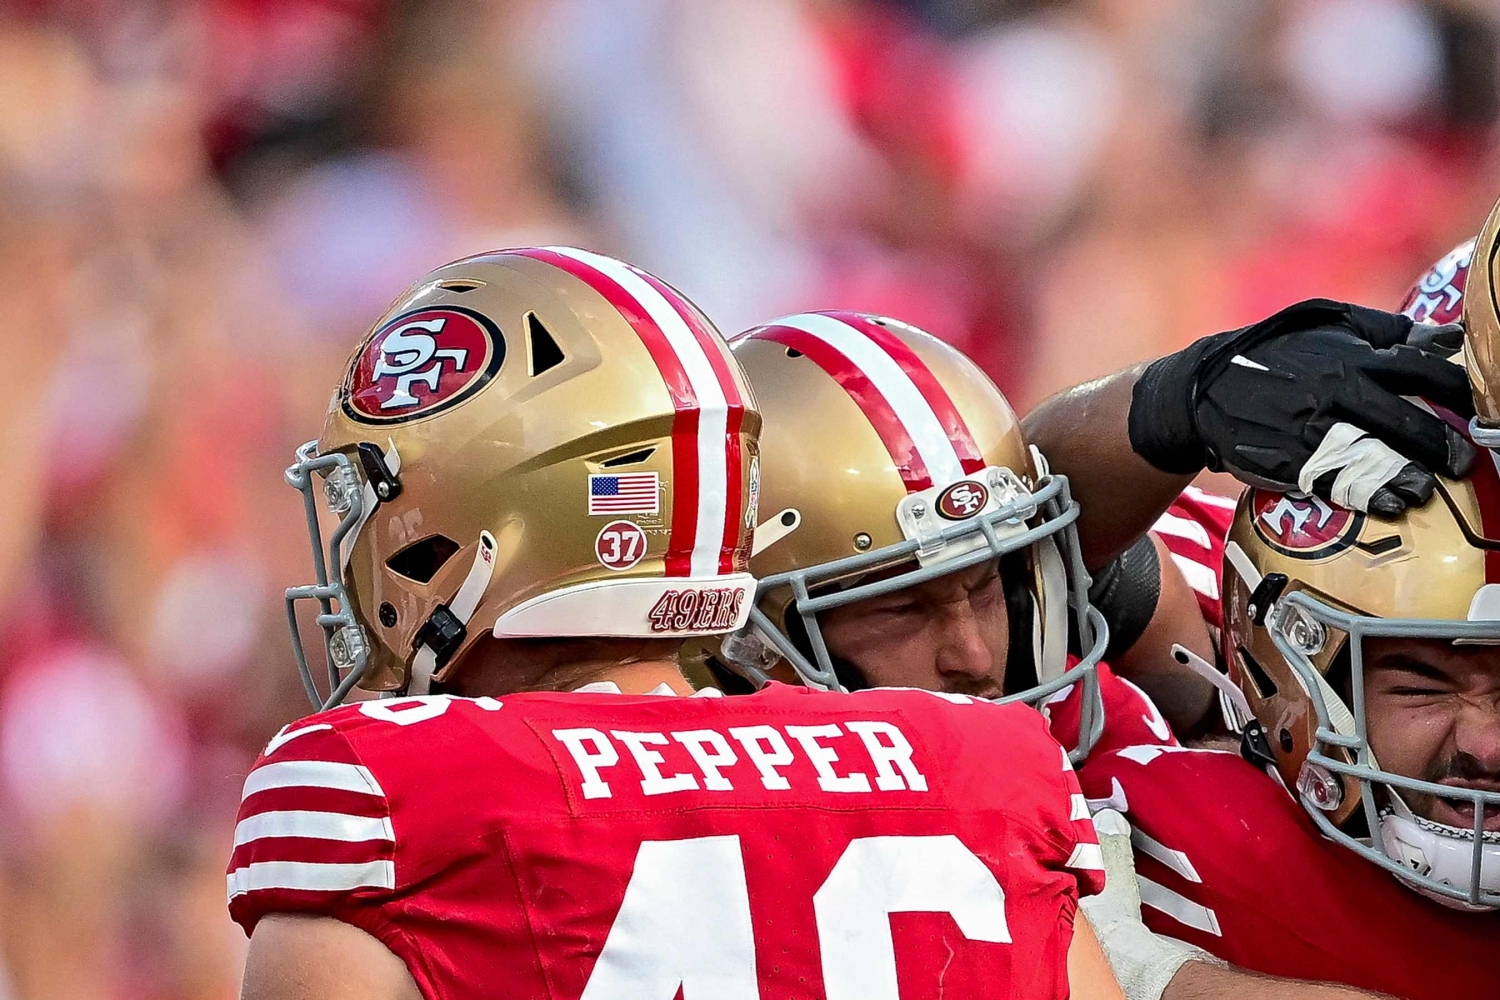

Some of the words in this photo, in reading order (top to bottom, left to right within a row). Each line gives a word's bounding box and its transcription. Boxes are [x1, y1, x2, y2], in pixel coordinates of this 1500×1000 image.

[372, 317, 468, 409] SF
[950, 484, 982, 515] SF
[601, 530, 640, 563] 37
[648, 587, 746, 632] 49ERS
[551, 720, 929, 800] PEPPER
